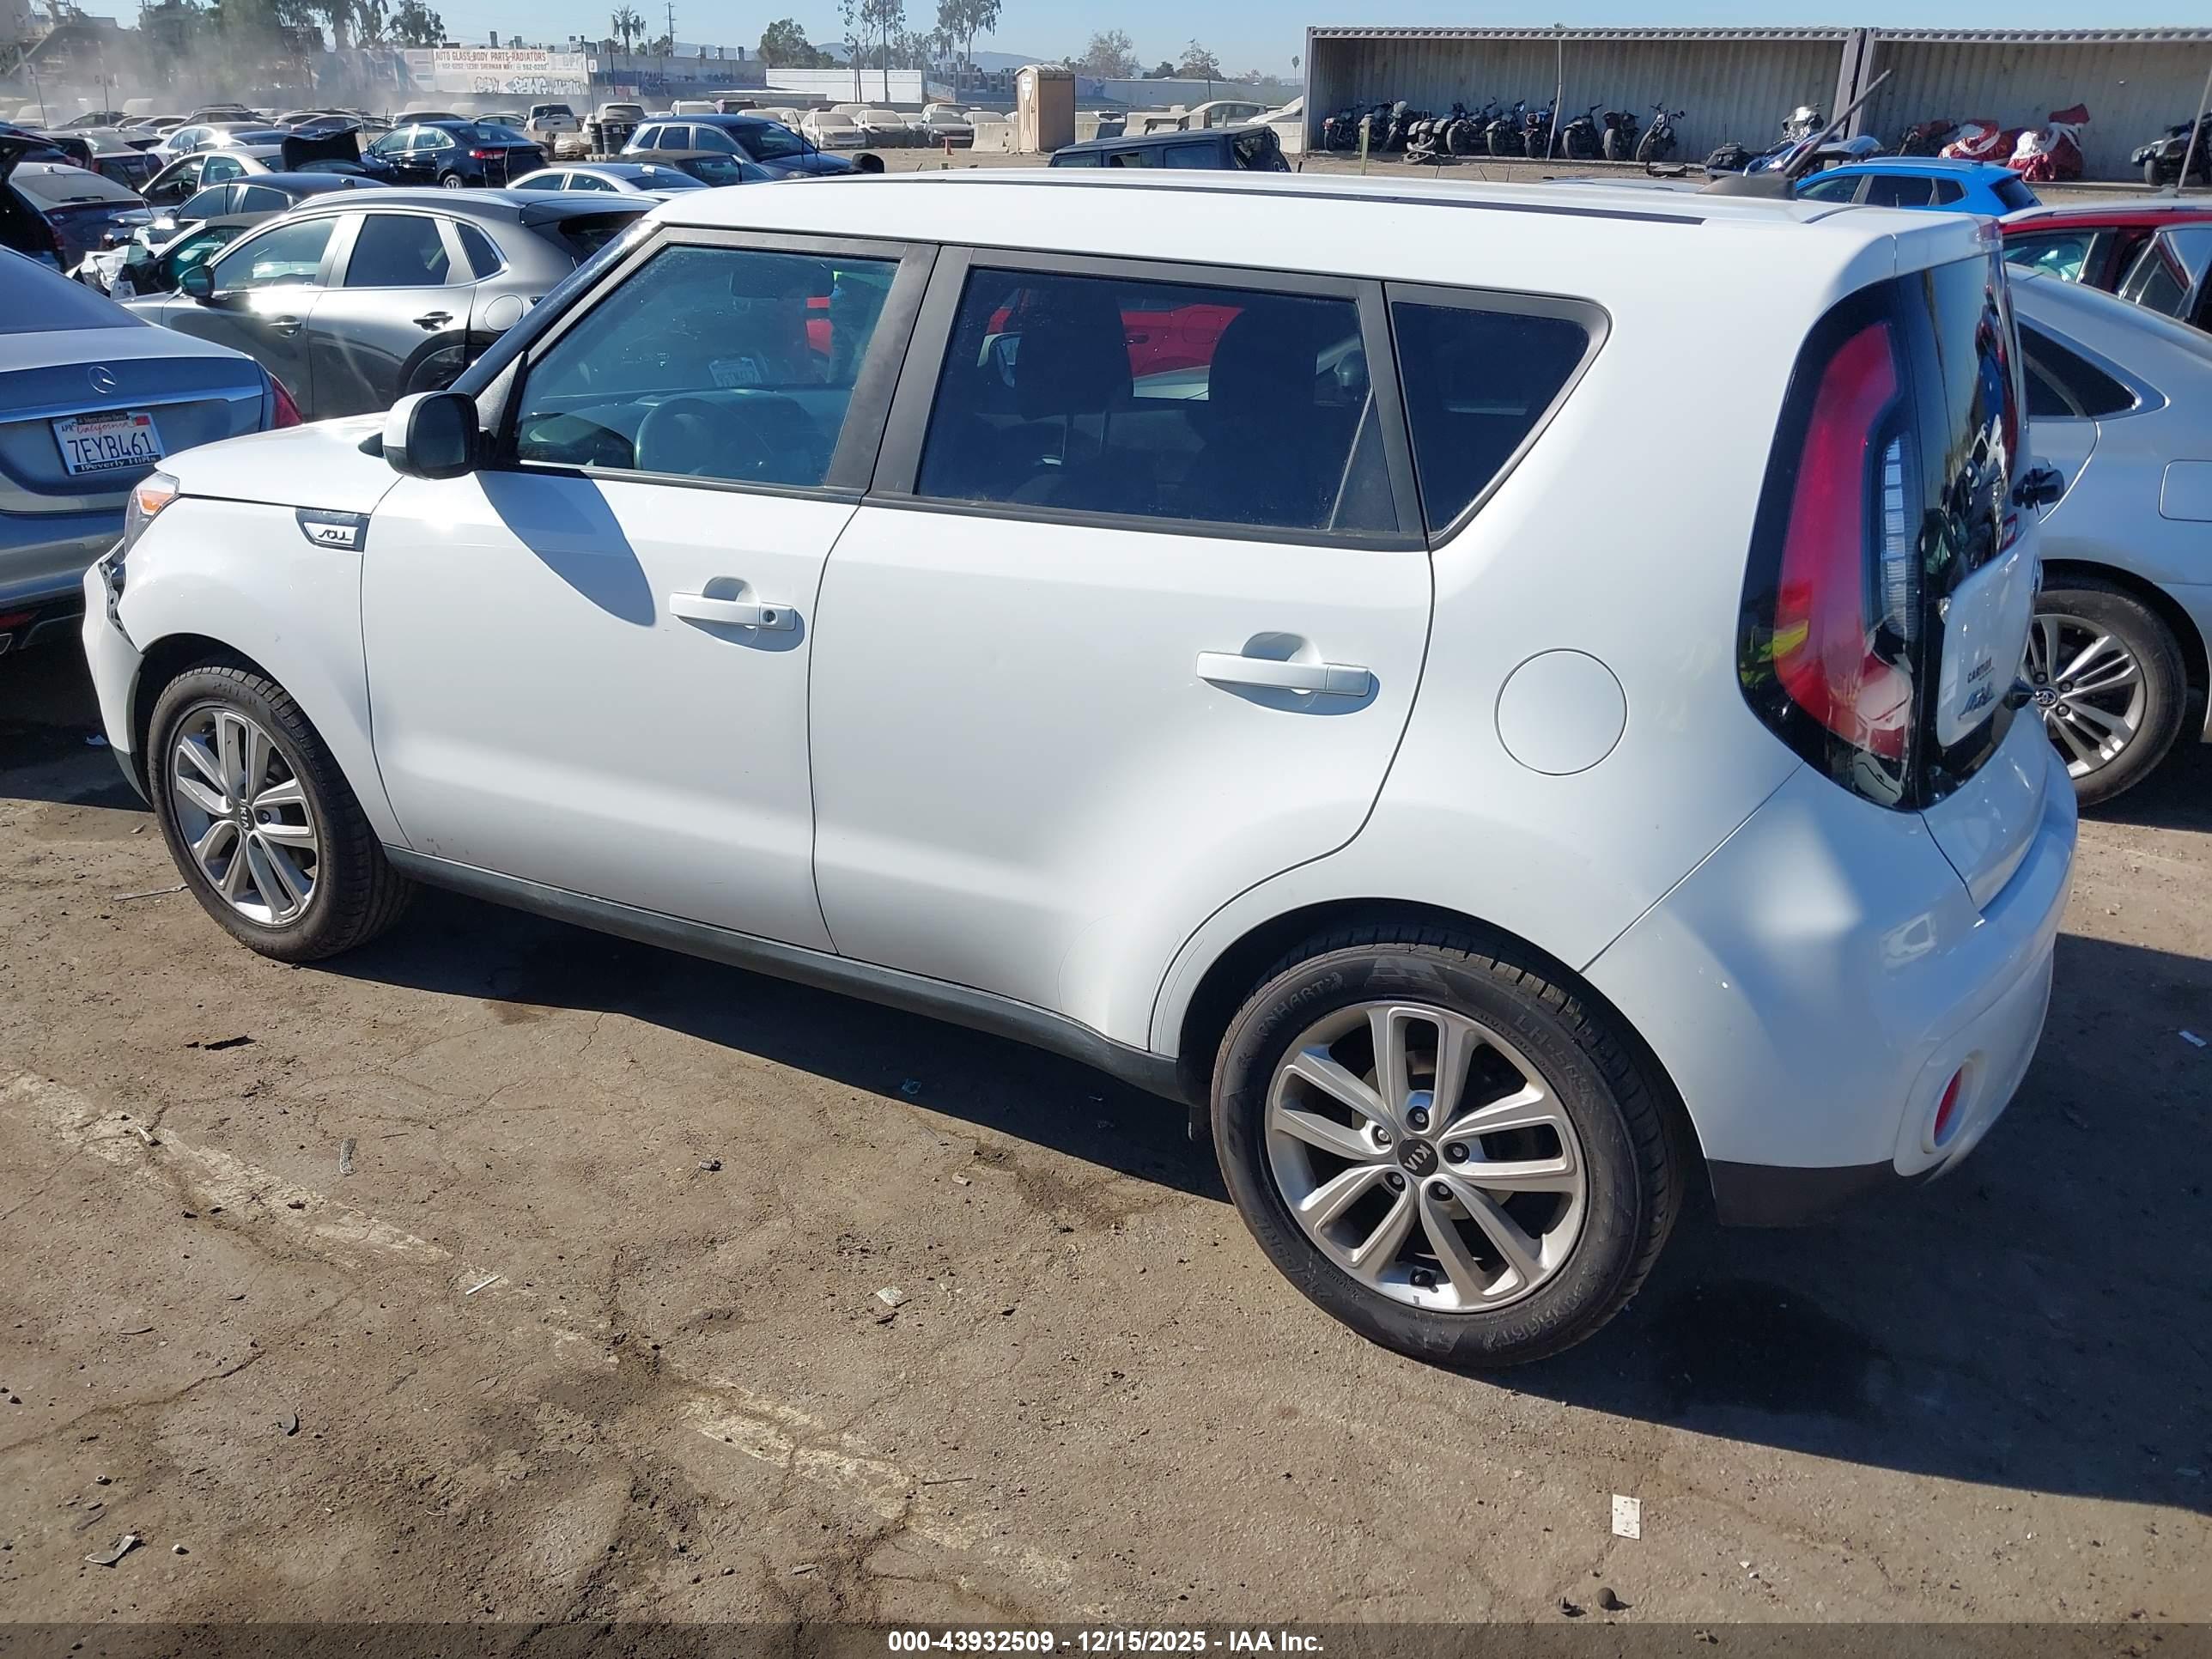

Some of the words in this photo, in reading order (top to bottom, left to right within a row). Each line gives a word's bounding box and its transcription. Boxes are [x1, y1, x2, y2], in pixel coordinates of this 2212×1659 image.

[435, 52, 451, 61] AUTO
[76, 420, 129, 434] California
[81, 459, 125, 471] Beverly
[240, 806, 249, 829] KIA
[1403, 1143, 1431, 1171] KIA
